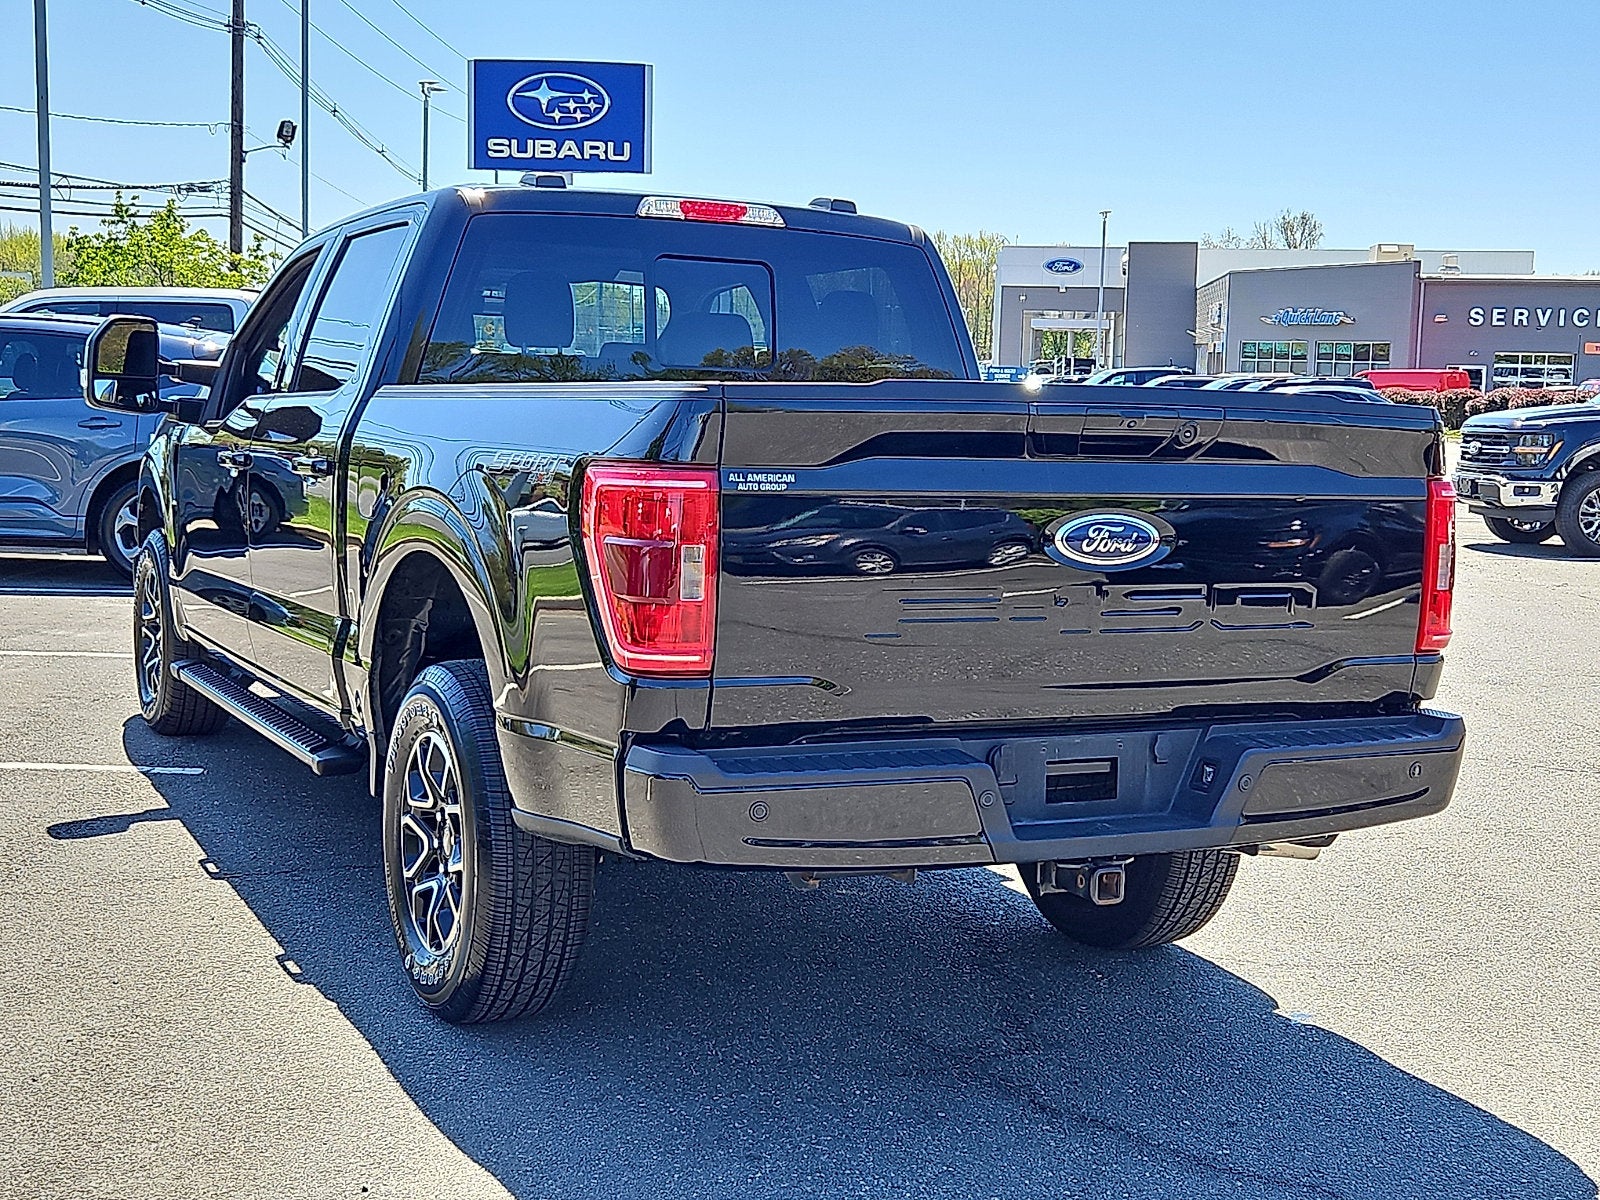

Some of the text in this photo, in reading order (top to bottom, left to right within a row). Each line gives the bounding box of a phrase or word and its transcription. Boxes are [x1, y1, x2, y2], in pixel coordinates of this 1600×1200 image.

[487, 138, 631, 161] SUBARU
[1052, 261, 1075, 272] Ford
[1281, 307, 1344, 327] Quick Lane
[1468, 307, 1600, 328] SERVIC
[488, 451, 575, 474] SPORT
[728, 473, 796, 483] ALL AMERICAN
[737, 483, 788, 491] AUTO GROUP
[1081, 524, 1139, 553] Ford
